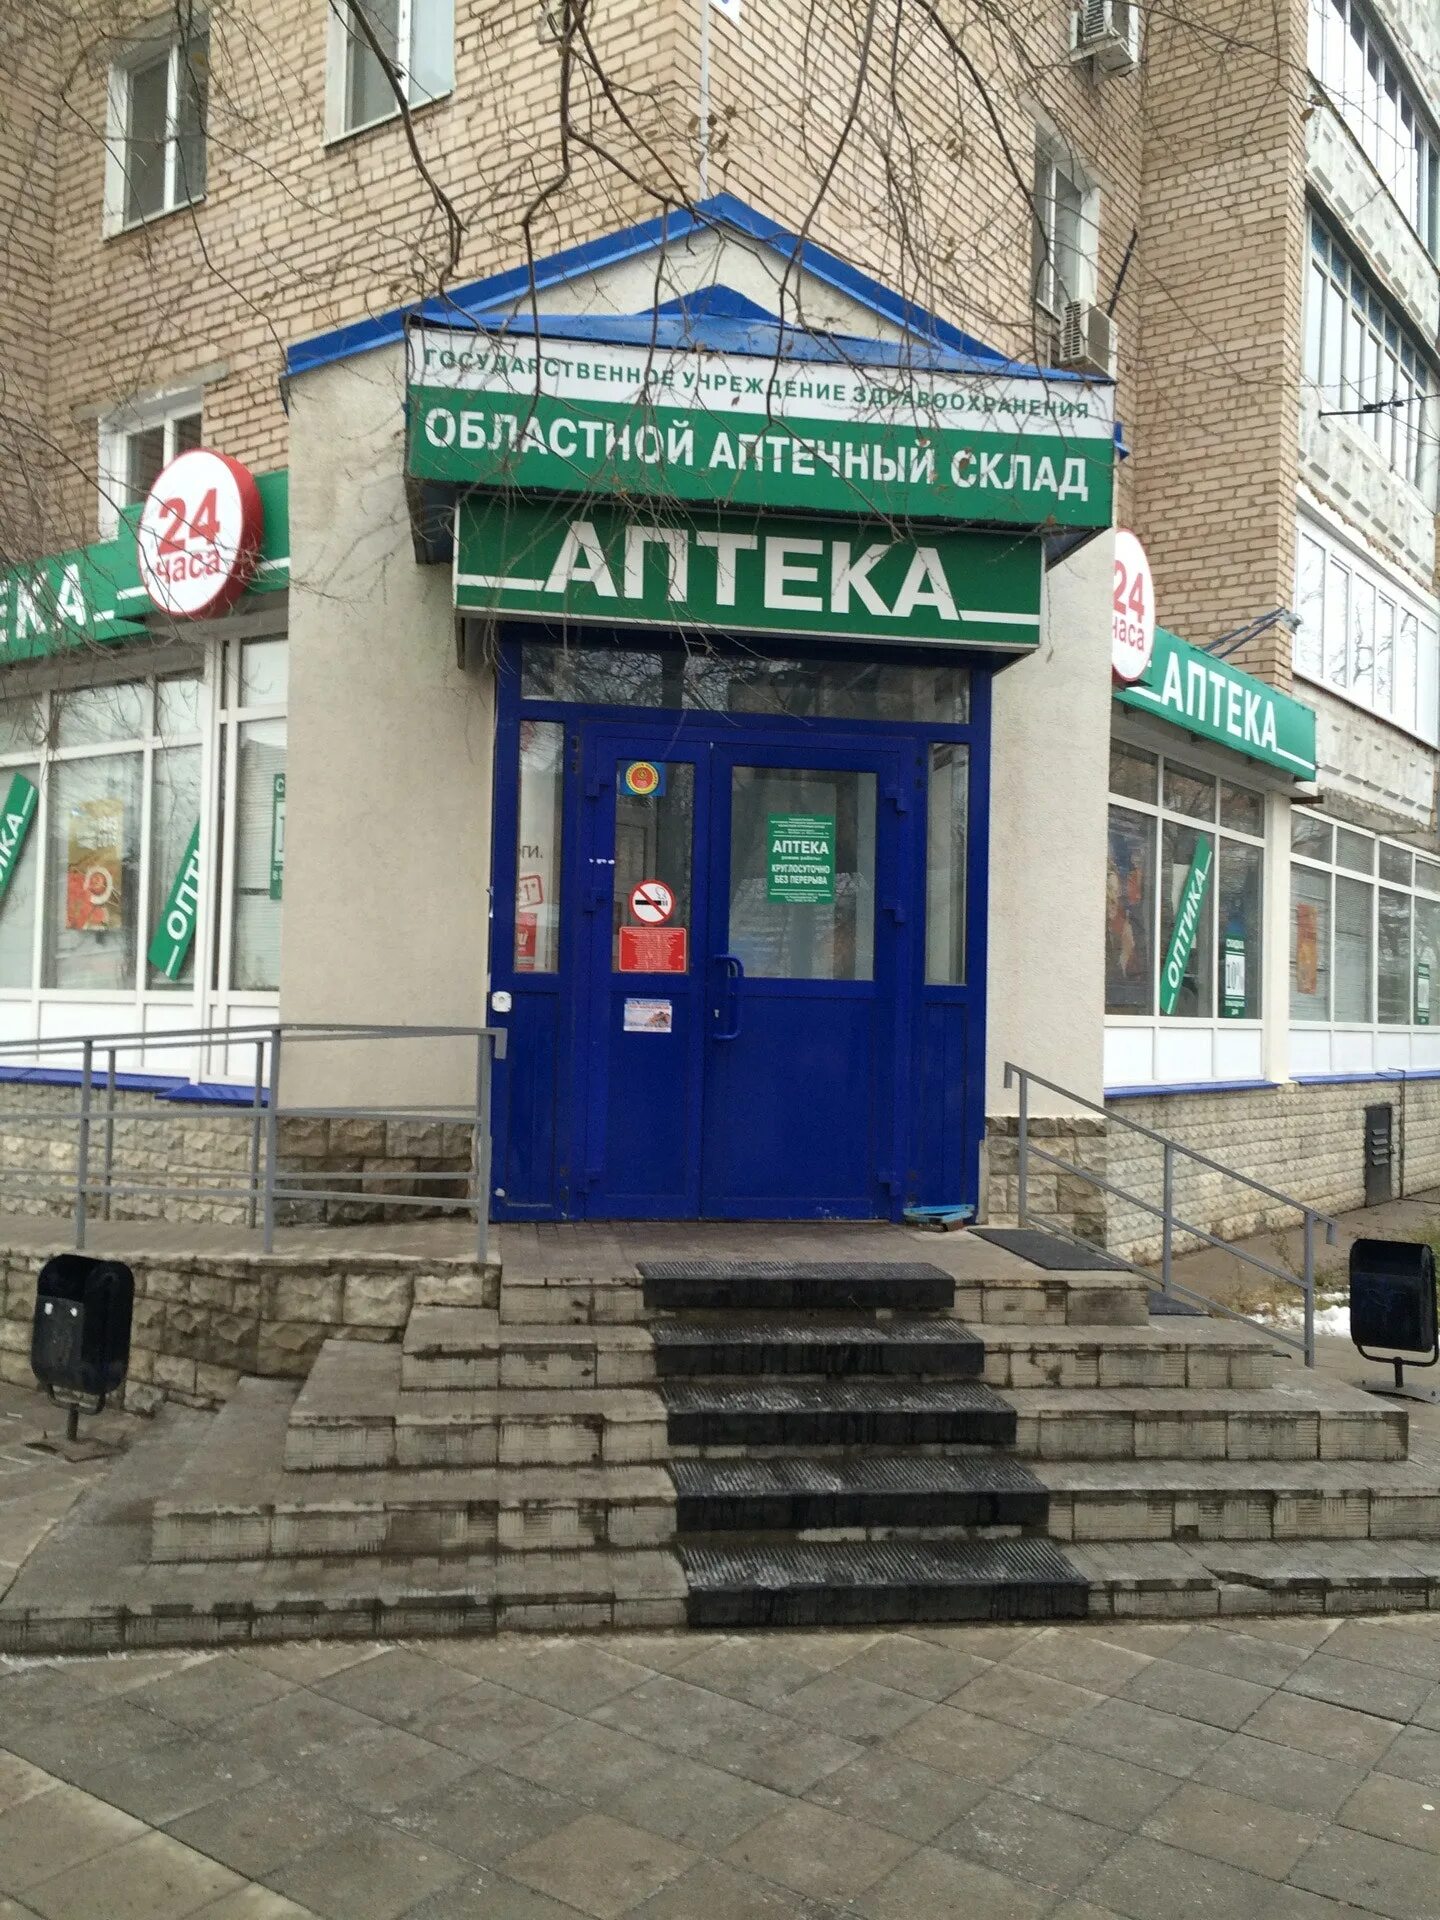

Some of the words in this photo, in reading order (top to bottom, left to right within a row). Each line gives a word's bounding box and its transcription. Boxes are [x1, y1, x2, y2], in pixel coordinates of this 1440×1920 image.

[425, 348, 674, 388] ГОСУДАРСТВЕННОЕ
[683, 372, 846, 401] УЧРЕЖДЕНИЕ
[853, 385, 1089, 418] ЗДРАВООХРАНЕНИЯ
[424, 406, 695, 467] ОБЛАСТНОЙ
[708, 432, 935, 485] АПТЕЧНЫЙ
[950, 450, 1089, 502] СКЛАД
[158, 487, 220, 555] 24
[543, 520, 961, 621] АПТЕКА
[1113, 560, 1145, 624] 24
[1160, 651, 1278, 752] АПТЕКА
[771, 864, 831, 874] КРУГЛОСУТОЧНО
[772, 840, 830, 855] АПТЕКА
[774, 874, 789, 884] БЕЗ
[790, 875, 828, 885] ПЕРЕРЫВА
[1167, 867, 1207, 989] ОПТИКА
